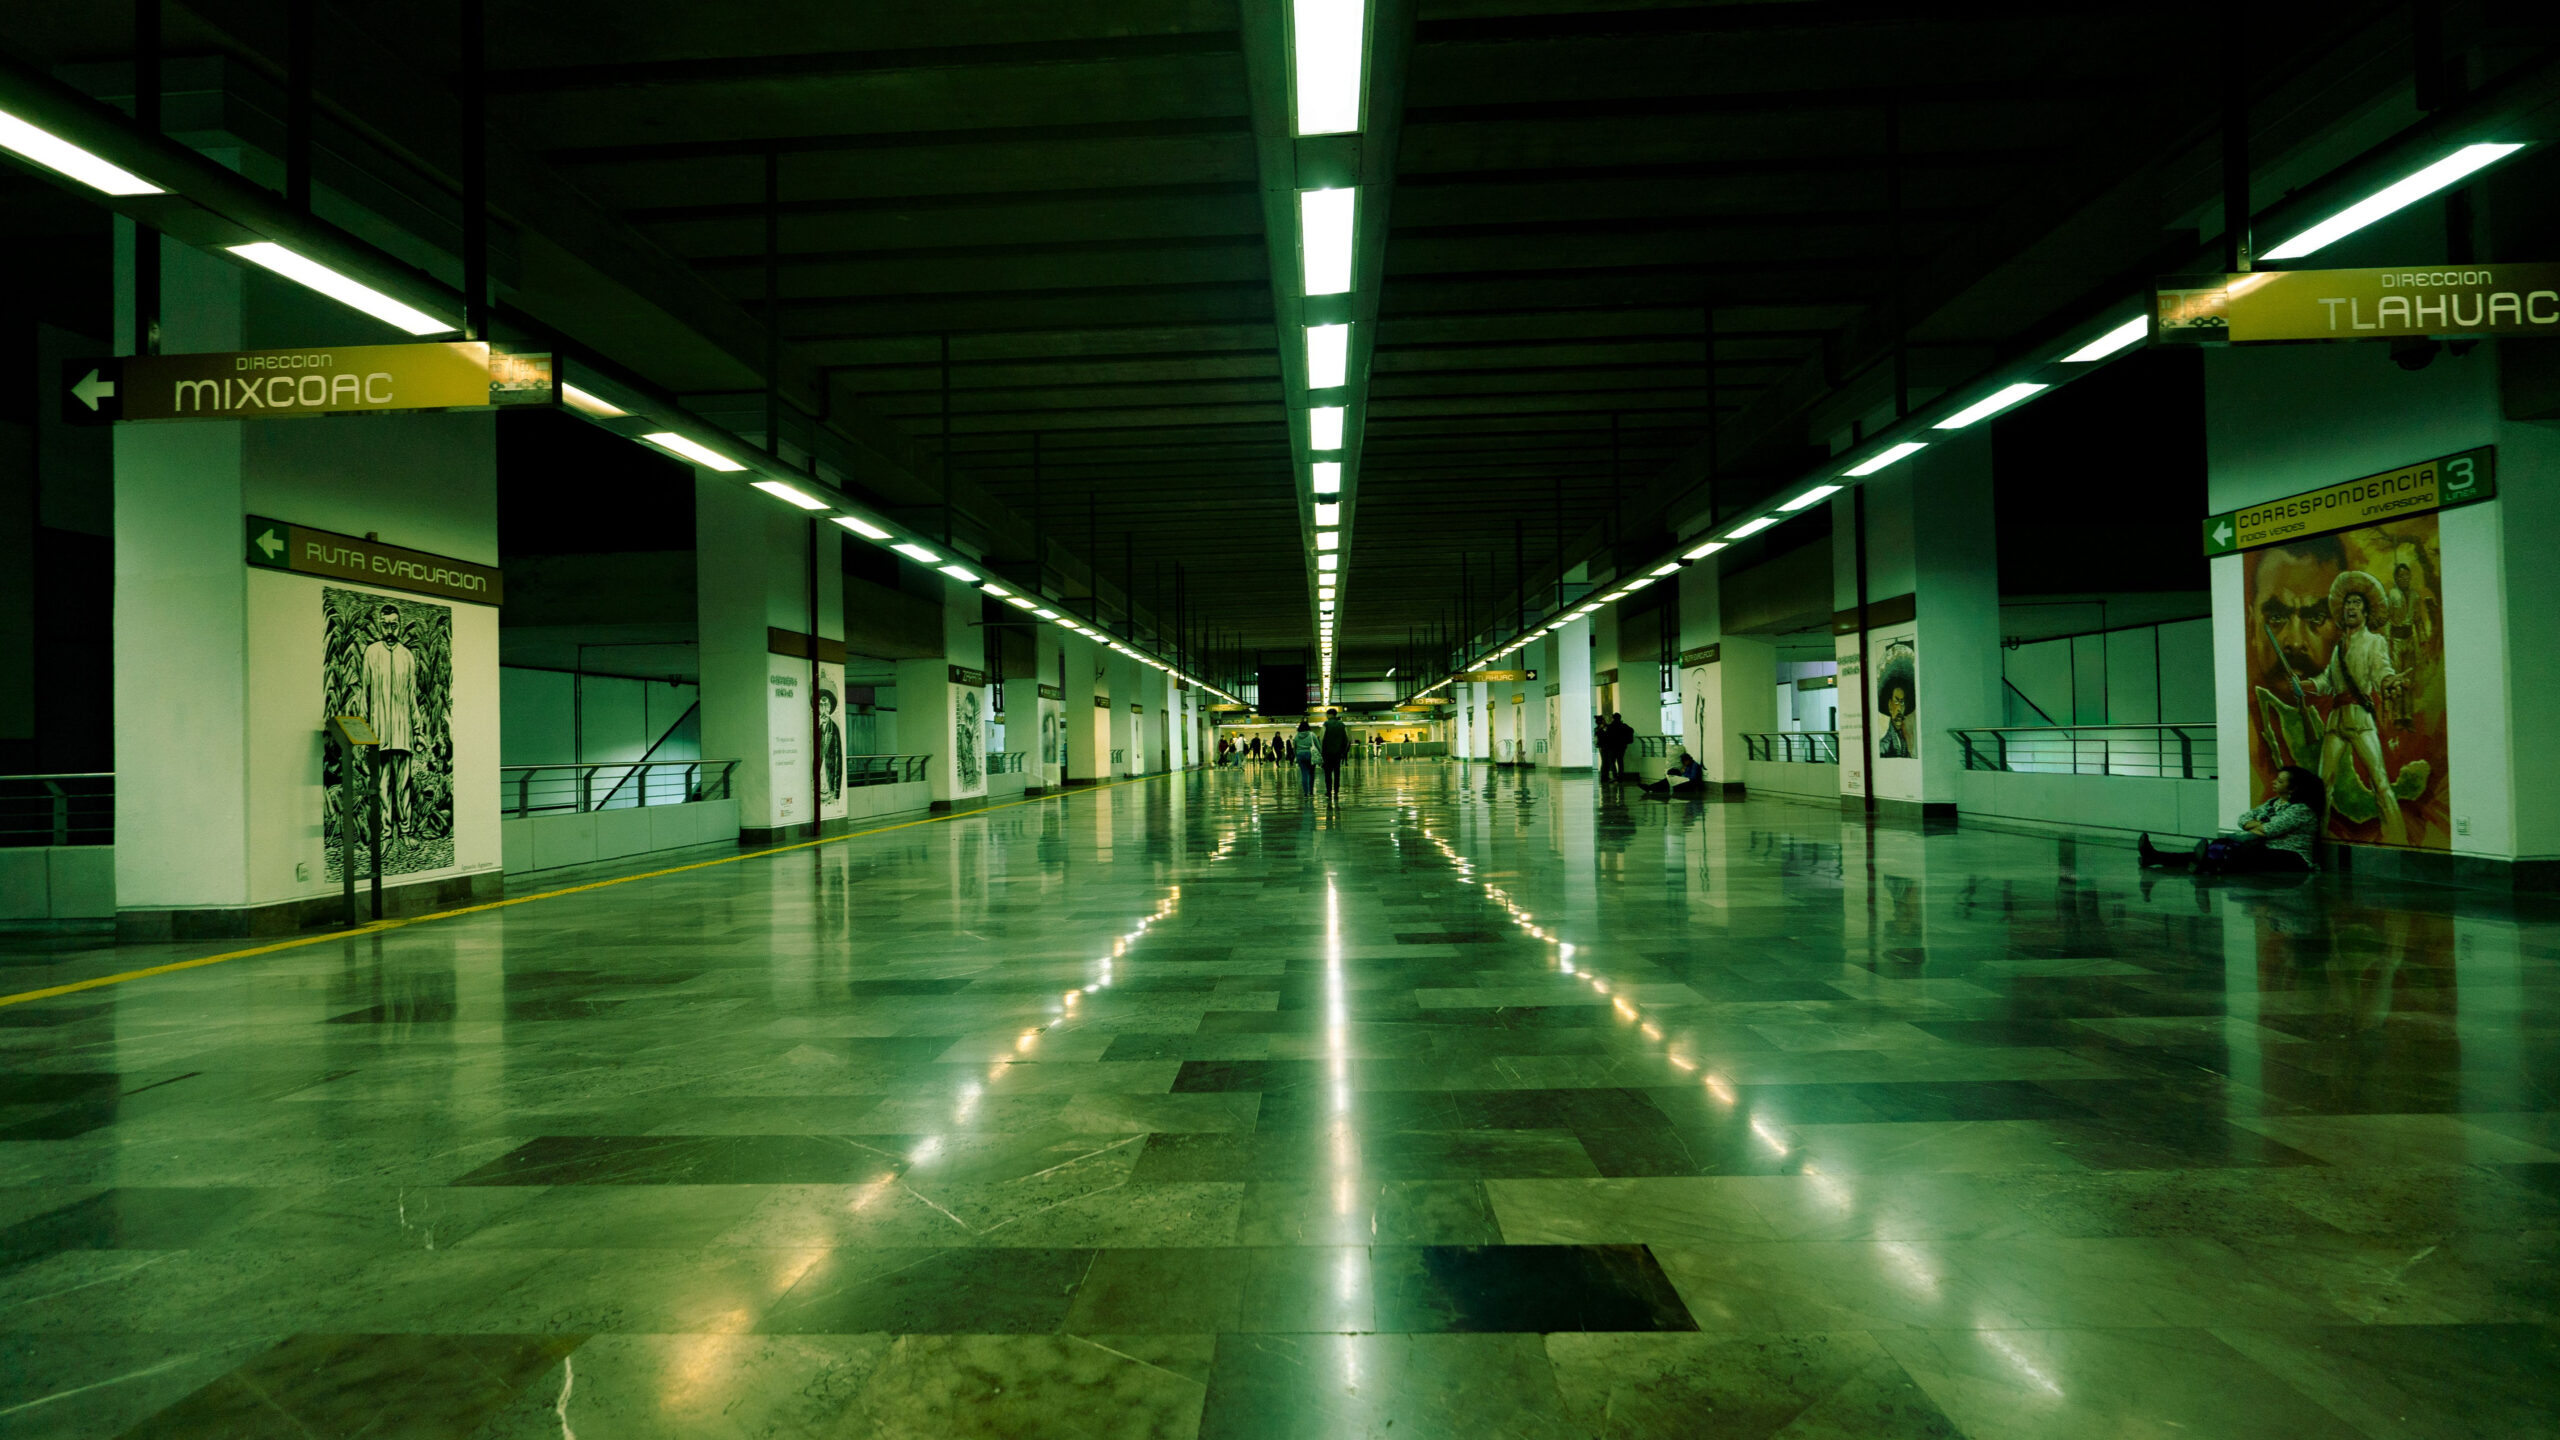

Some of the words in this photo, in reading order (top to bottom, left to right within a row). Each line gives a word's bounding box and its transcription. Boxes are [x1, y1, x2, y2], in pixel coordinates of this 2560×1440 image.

[2381, 270, 2493, 288] DIRECCION
[2317, 290, 2560, 331] TLAHUAC
[235, 353, 333, 371] DIRECCION
[174, 372, 394, 412] MIXCOAC
[2446, 456, 2475, 491] 3
[2239, 469, 2435, 529] CORRESPONDENCIA
[2361, 493, 2434, 515] UNIVERSIDAD
[2445, 487, 2478, 501] LINEA
[2240, 530, 2267, 543] INDIOS
[2269, 521, 2306, 537] VERDES
[305, 542, 366, 570] RUTA
[371, 555, 487, 593] EVACUACION
[1476, 674, 1514, 682] TLAHUAC
